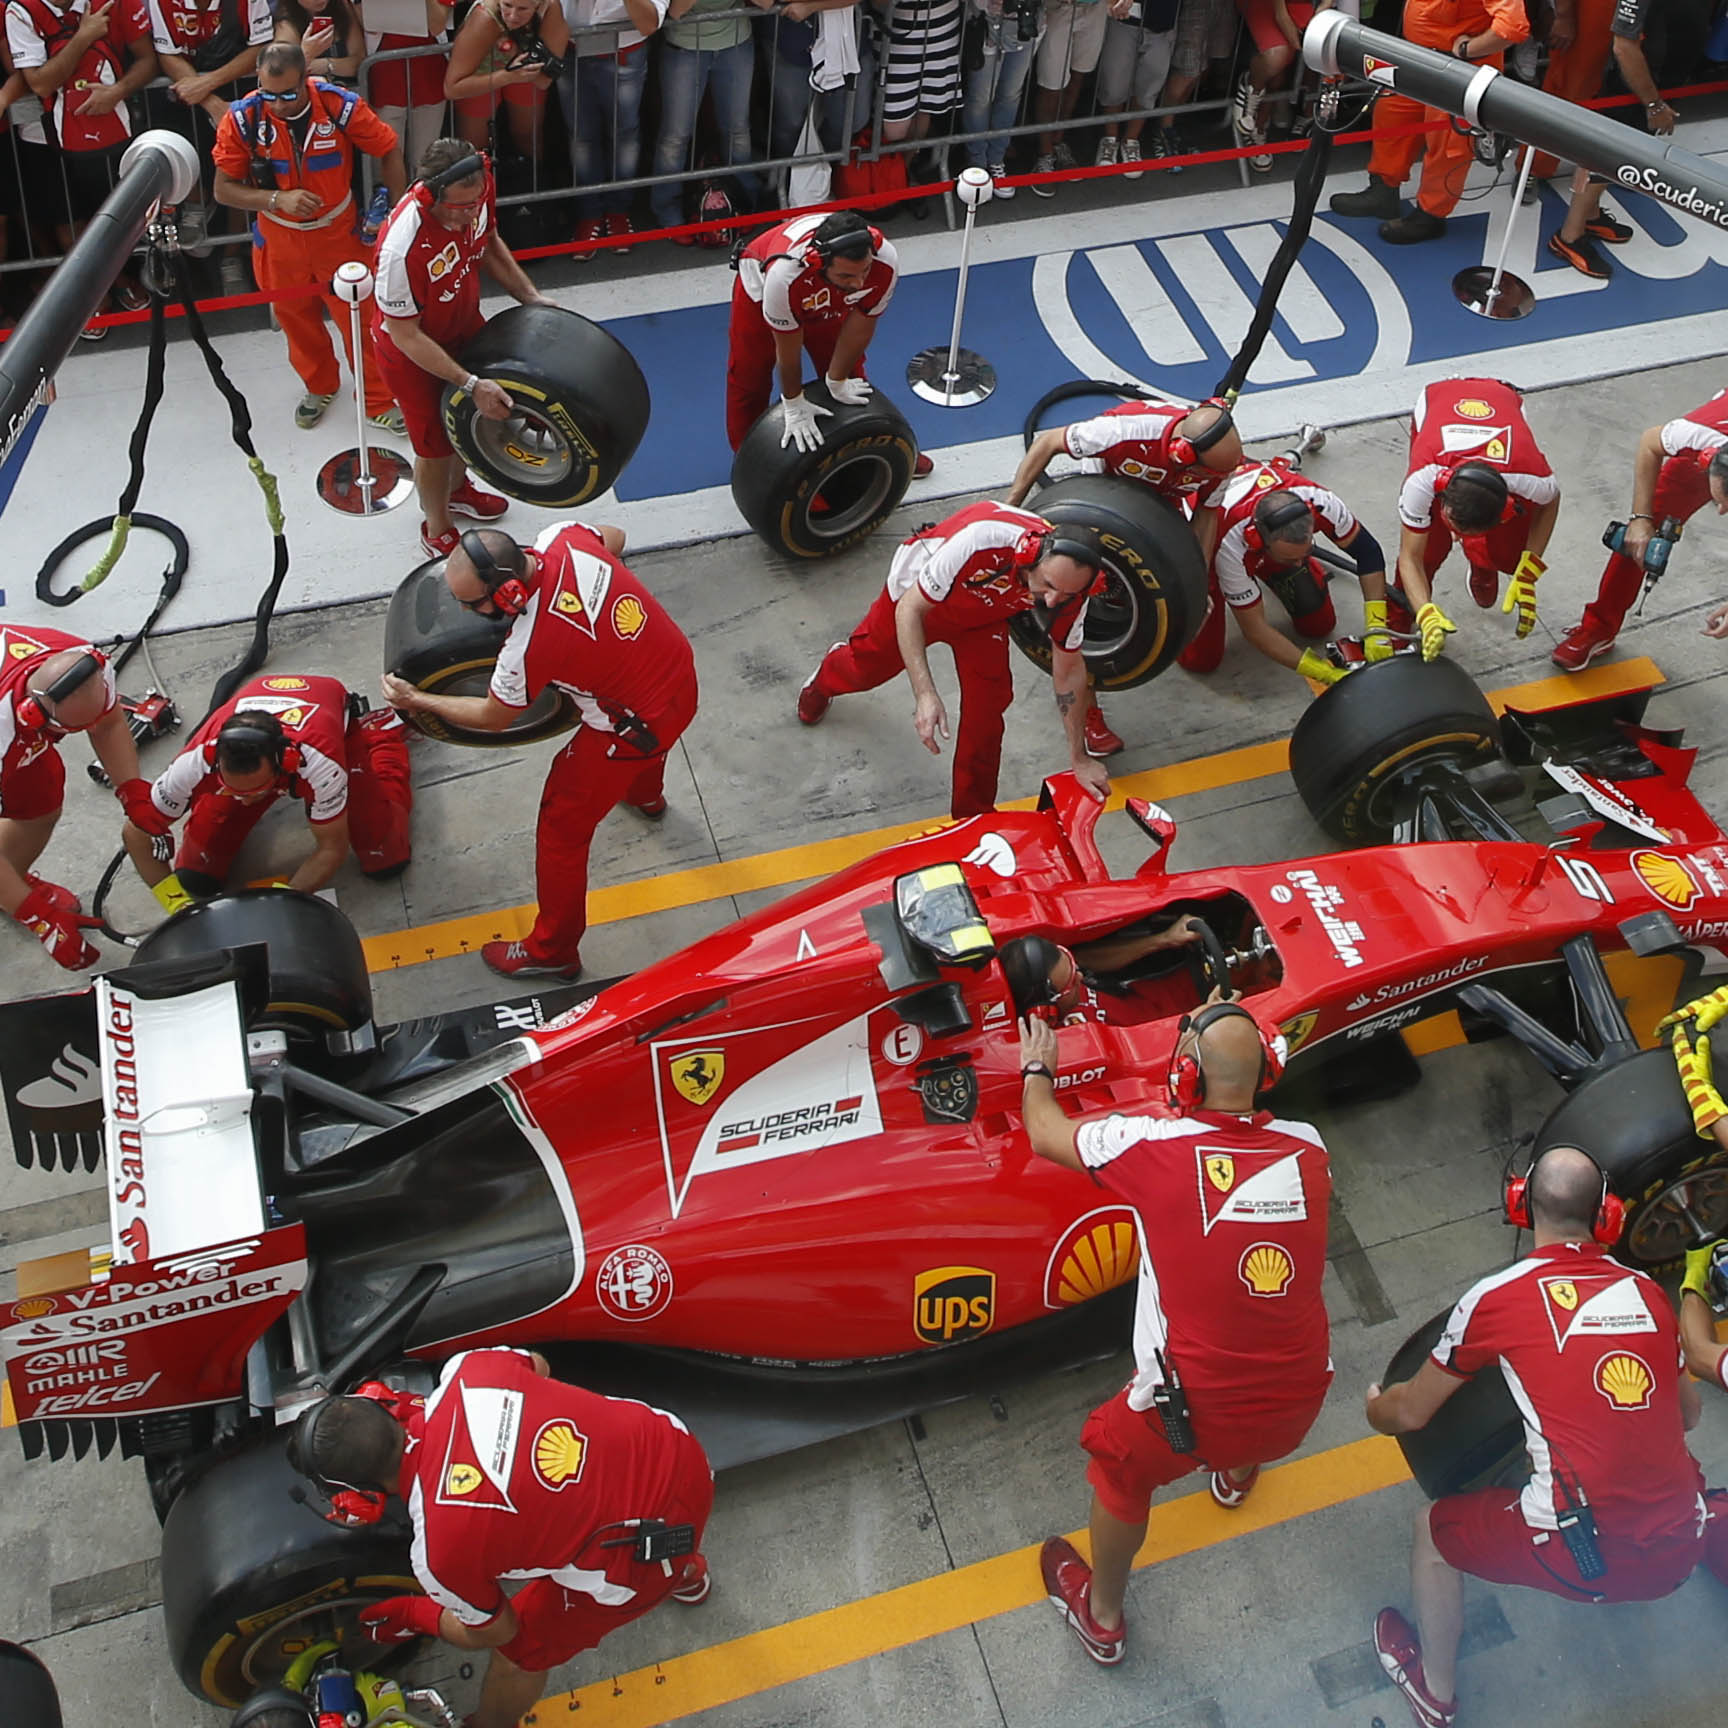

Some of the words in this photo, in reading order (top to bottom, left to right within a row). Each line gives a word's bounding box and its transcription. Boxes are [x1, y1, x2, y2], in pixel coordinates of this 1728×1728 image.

[1090, 526, 1160, 590] ERO
[1373, 956, 1489, 1003] Santander
[894, 1025, 912, 1059] E
[1053, 1065, 1106, 1089] BLOT
[107, 993, 145, 1209] Santander
[719, 1103, 832, 1139] SCUDERIA
[763, 1111, 861, 1144] FERRARI
[65, 1259, 235, 1310] V-Power
[600, 1256, 621, 1290] ALFA
[626, 1250, 668, 1284] ROMEO
[70, 1274, 284, 1336] Santander
[920, 1296, 989, 1339] ups
[27, 1364, 129, 1393] MAHLE
[33, 1371, 162, 1417] telcel
